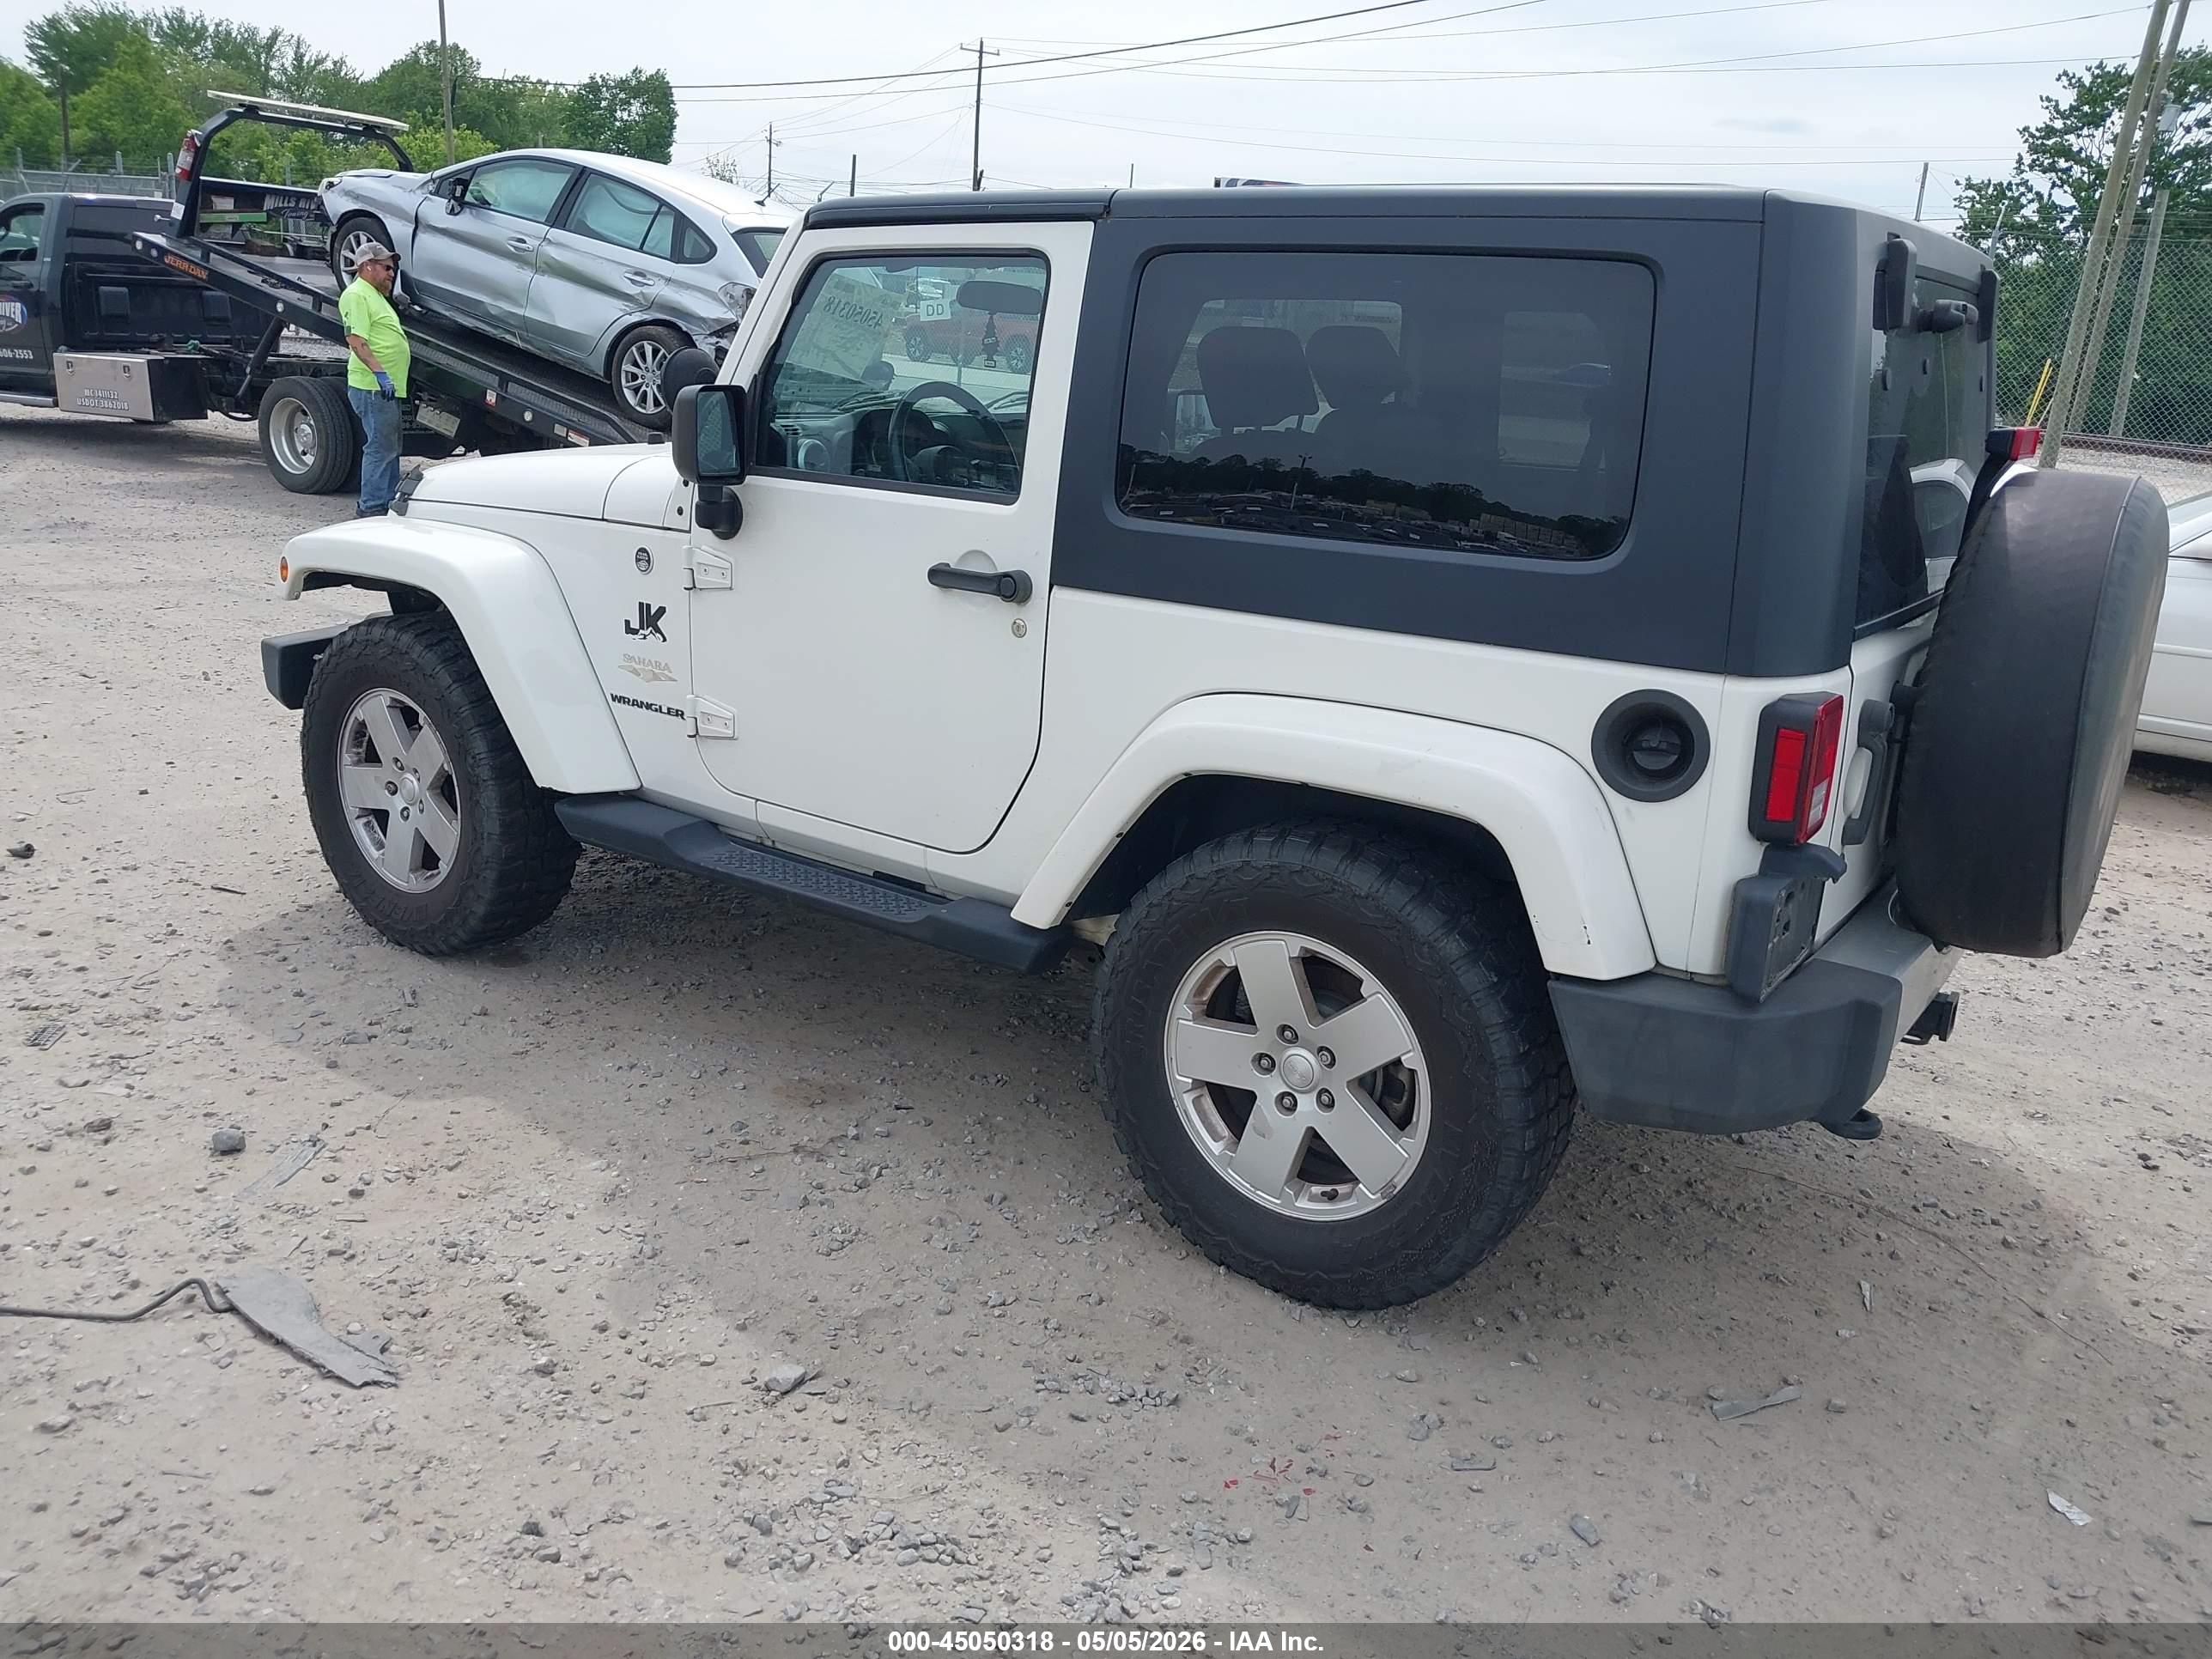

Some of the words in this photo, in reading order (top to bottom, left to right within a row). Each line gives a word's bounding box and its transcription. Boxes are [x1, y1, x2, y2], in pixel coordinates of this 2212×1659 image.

[264, 194, 296, 210] MILLS
[624, 601, 667, 642] JK
[623, 653, 672, 673] SAHARA
[610, 692, 686, 720] WRANGLER
